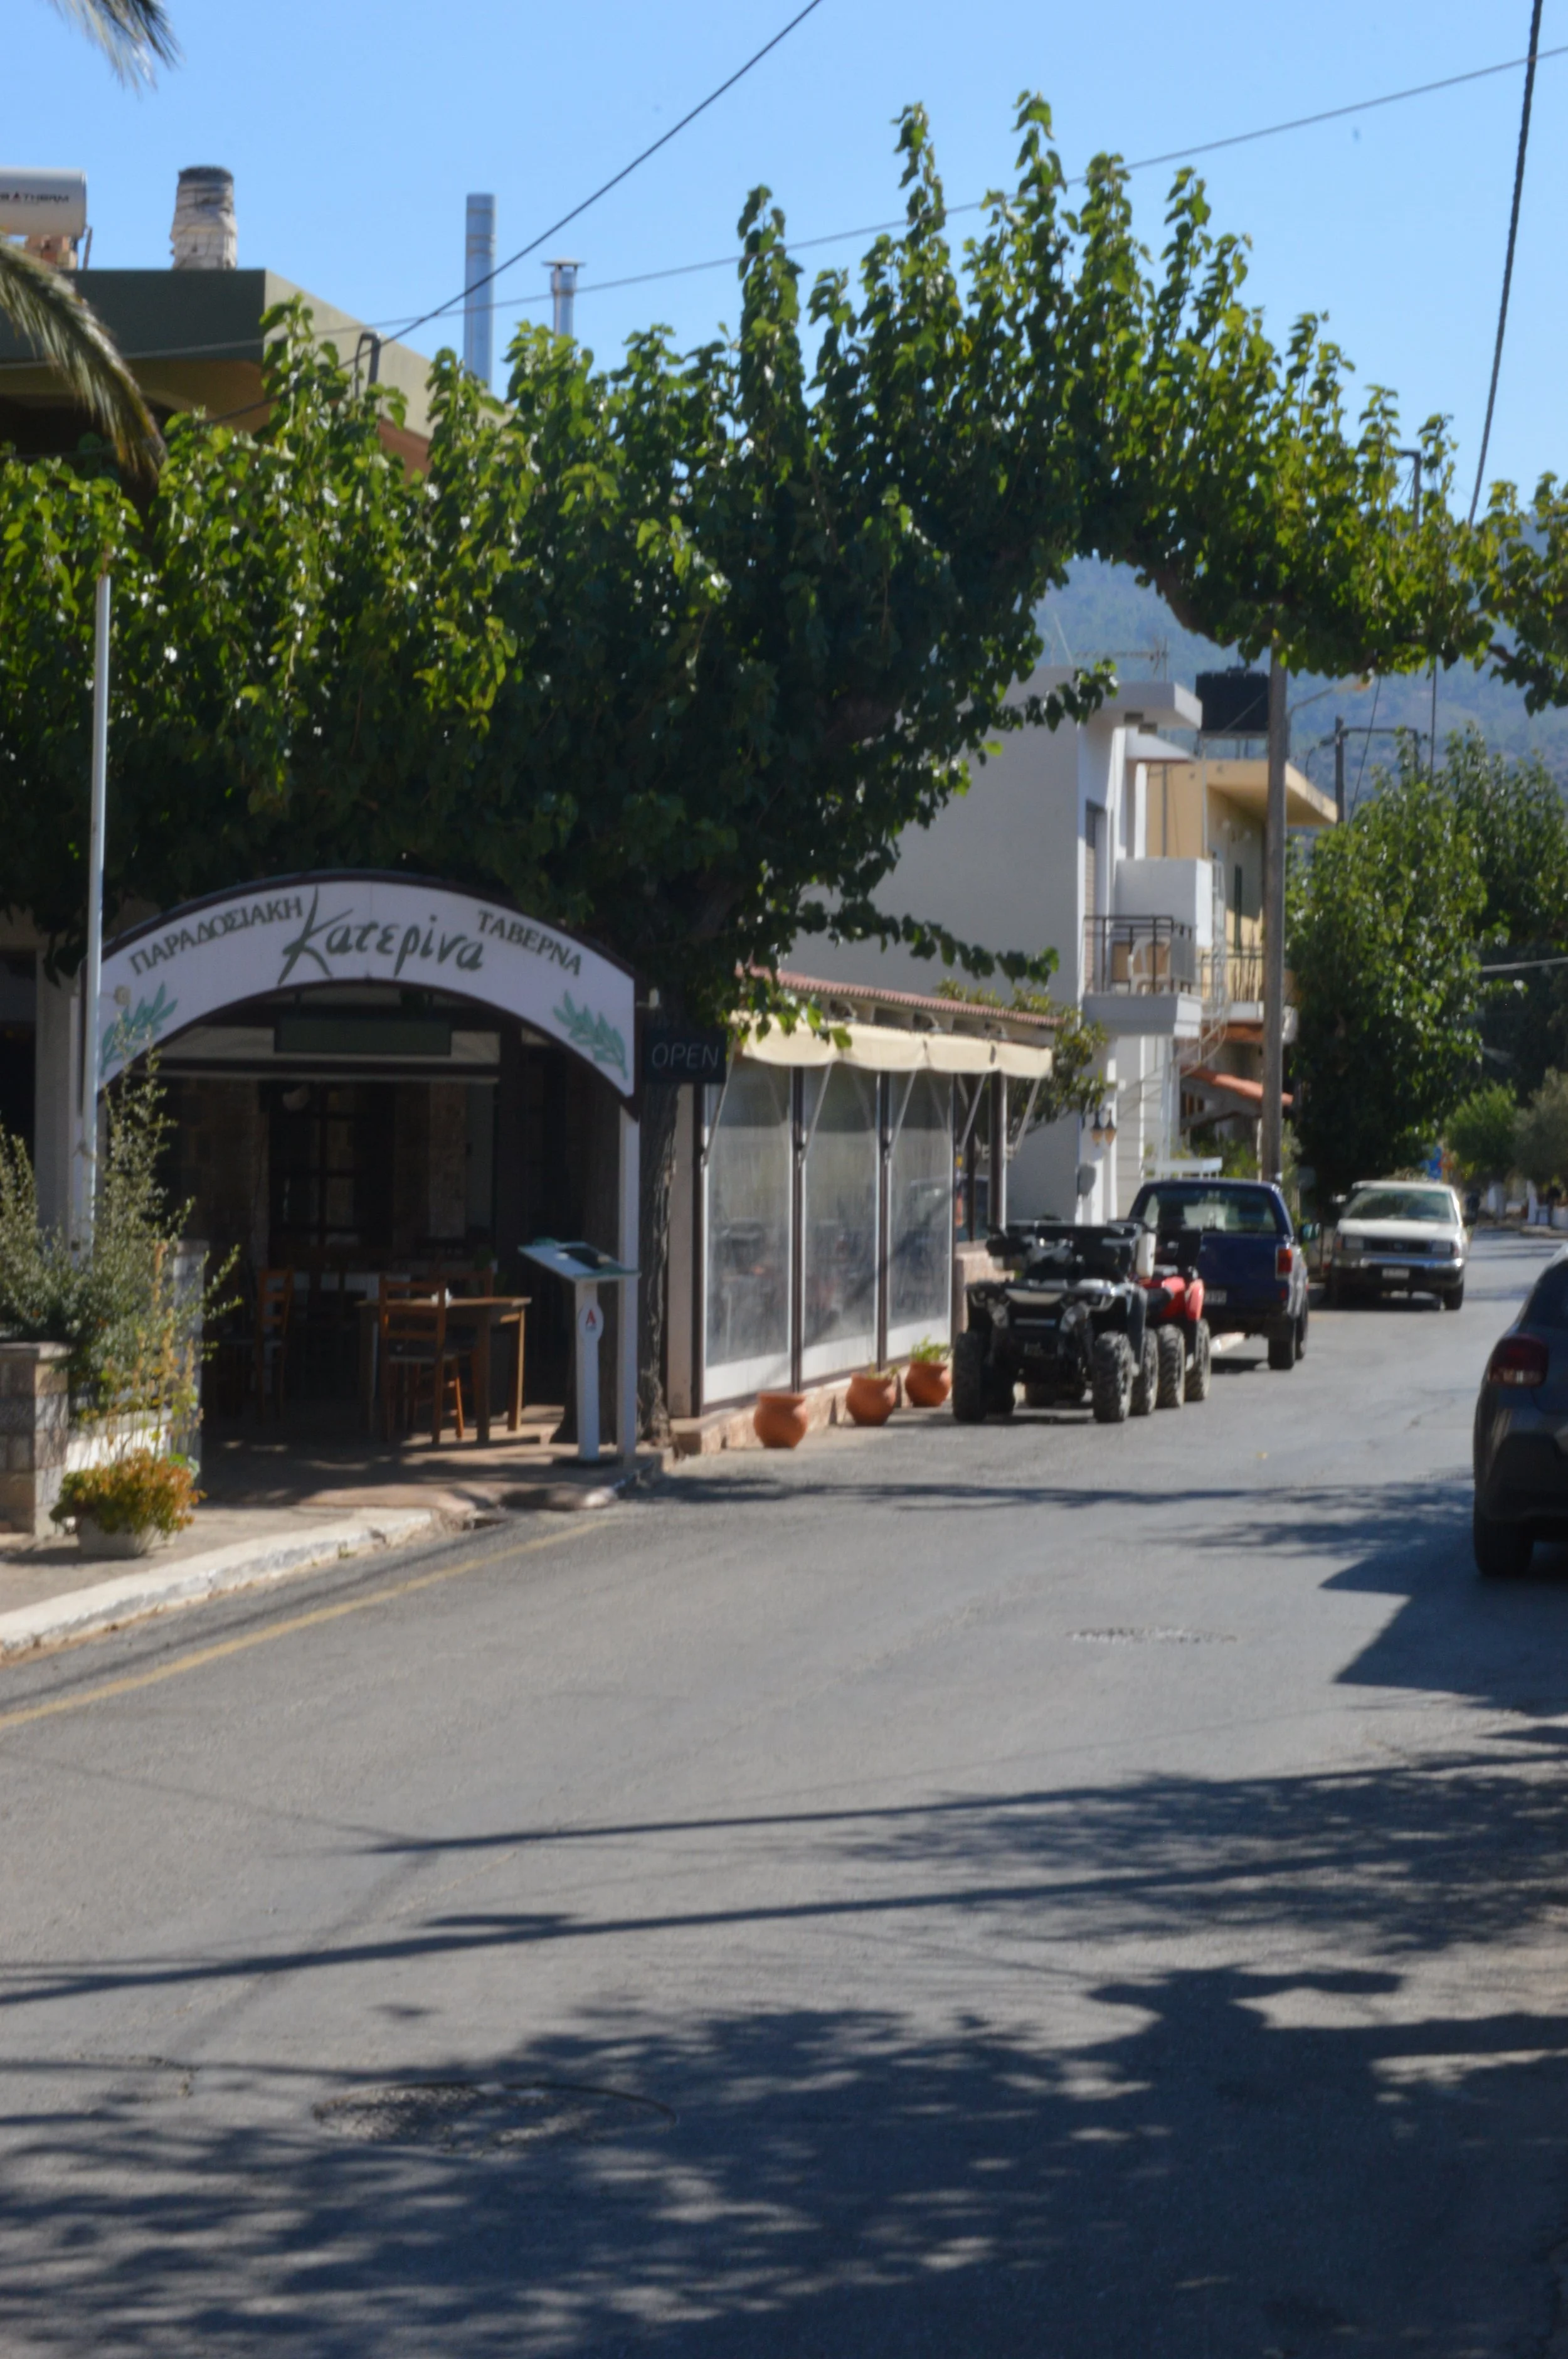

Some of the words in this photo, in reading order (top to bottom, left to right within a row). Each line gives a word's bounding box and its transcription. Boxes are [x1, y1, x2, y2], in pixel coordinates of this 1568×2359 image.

[129, 896, 302, 976] ΠΑΡΑΔΟΣΙΑΚΗ
[478, 909, 581, 976] ΤΑΒΕΡΝΑ
[652, 1042, 719, 1070] OPEN
